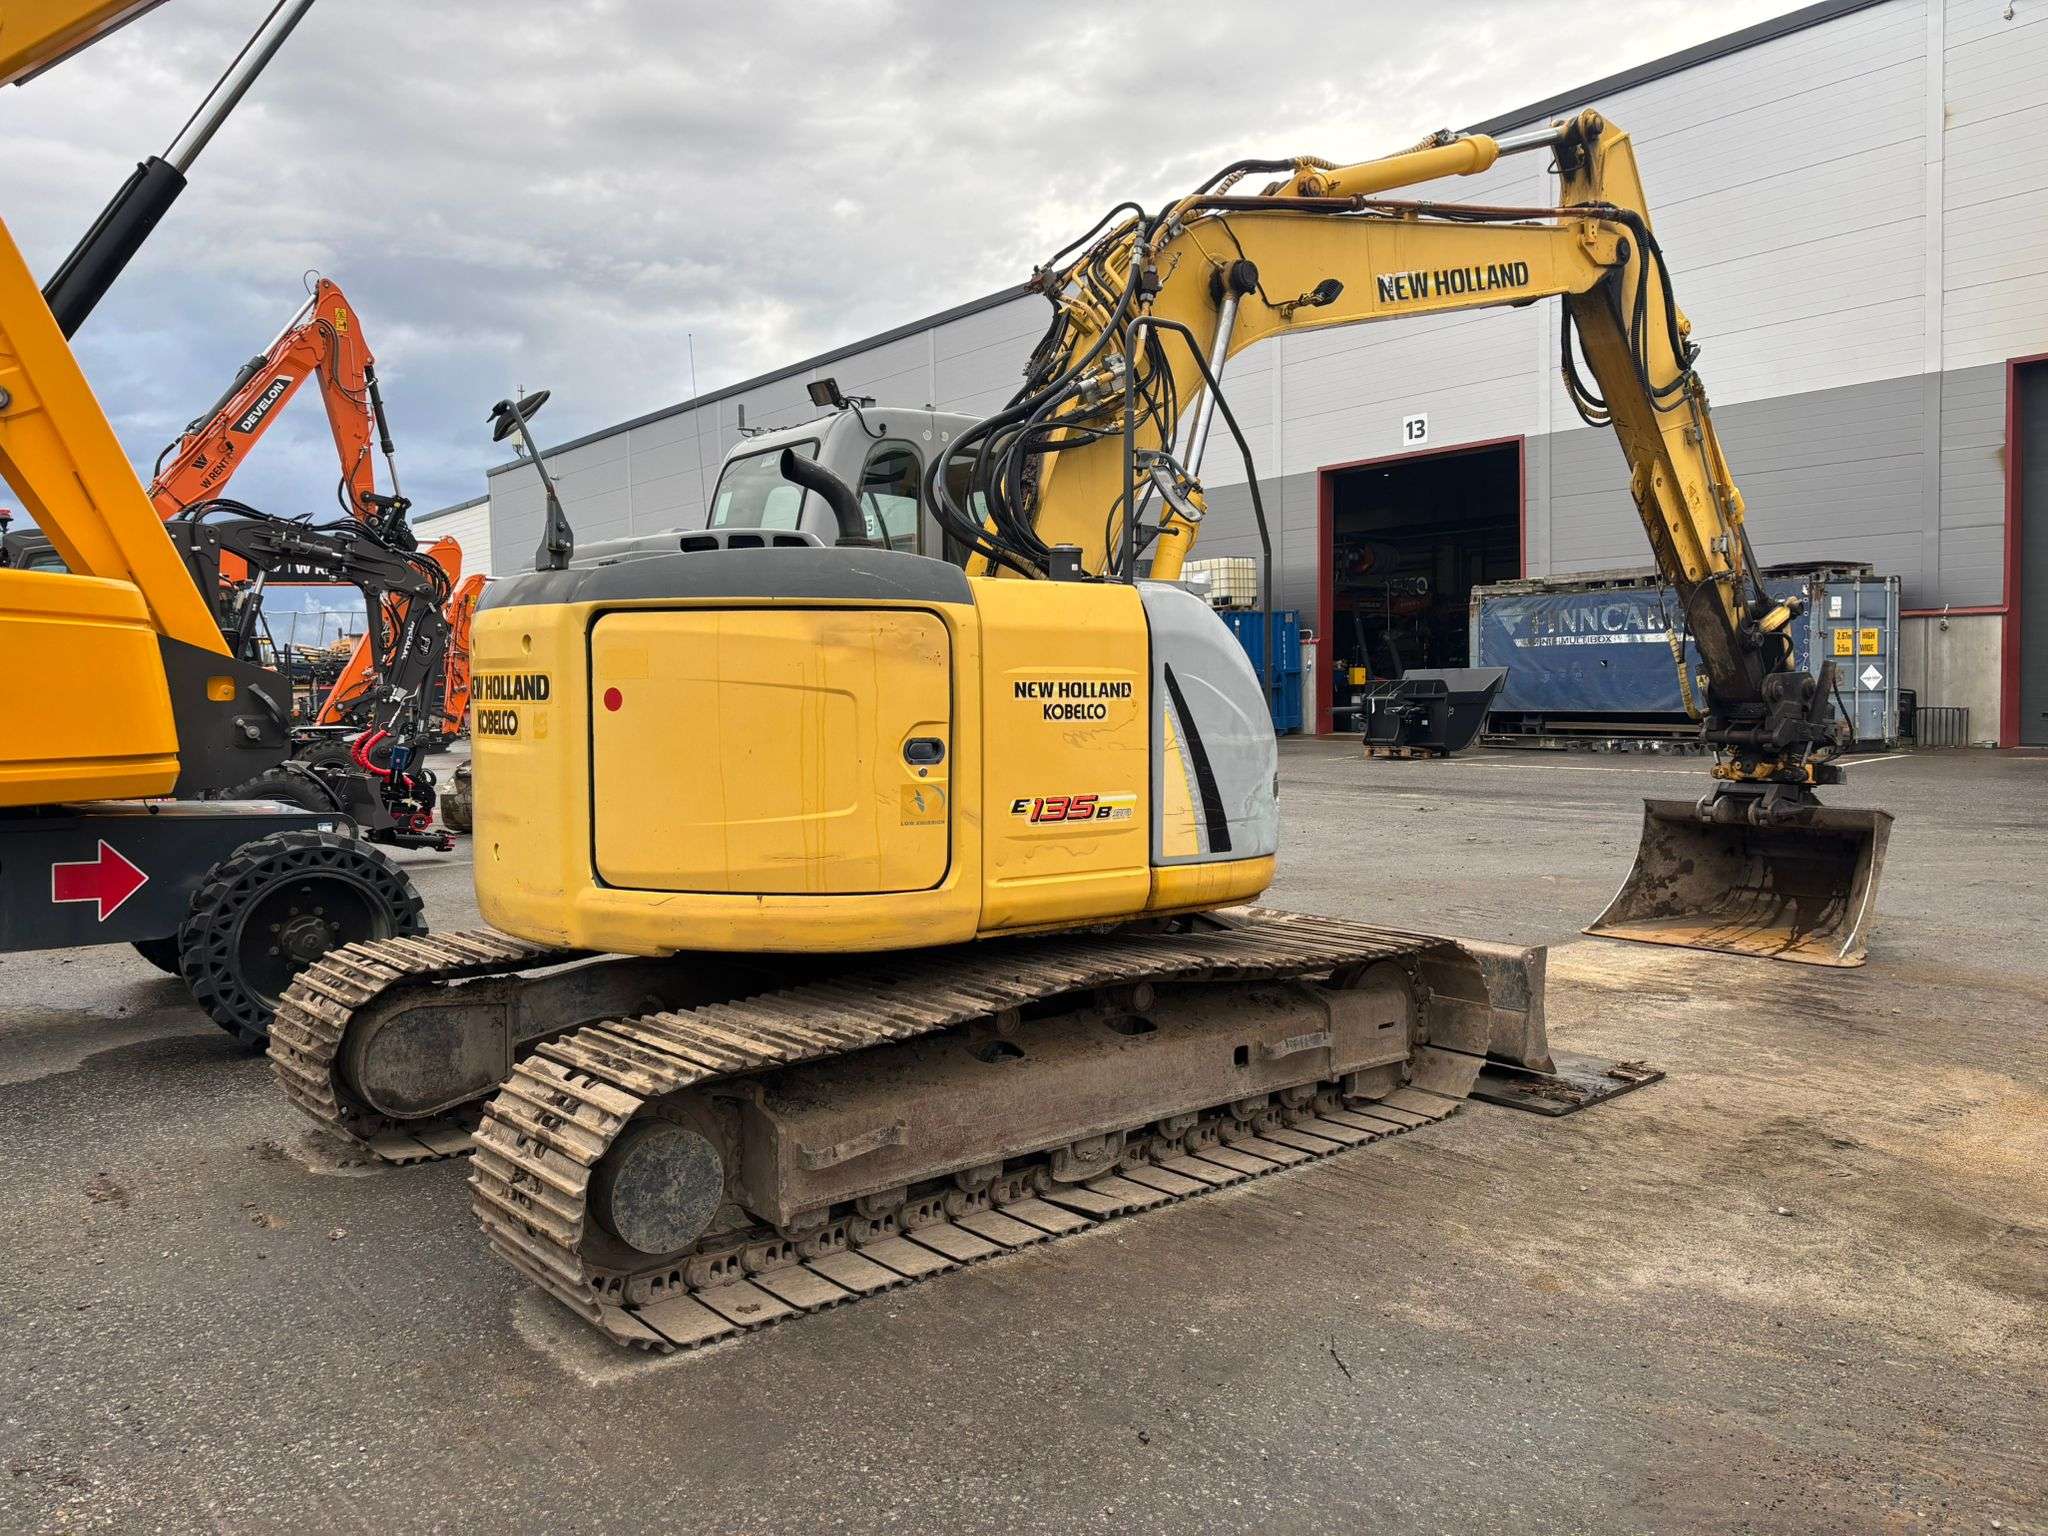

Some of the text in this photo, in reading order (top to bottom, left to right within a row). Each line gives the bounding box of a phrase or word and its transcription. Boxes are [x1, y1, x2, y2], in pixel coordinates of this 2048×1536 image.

[1377, 261, 1529, 302] NEW HOLLAND
[241, 381, 285, 431] DEVELON
[1406, 420, 1426, 439] 13
[201, 456, 231, 489] W RENT
[485, 675, 550, 700] HOLLAND
[1014, 682, 1132, 698] NEW HOLLAND
[478, 710, 519, 736] KOBELCO
[1043, 704, 1106, 720] KOBELCO
